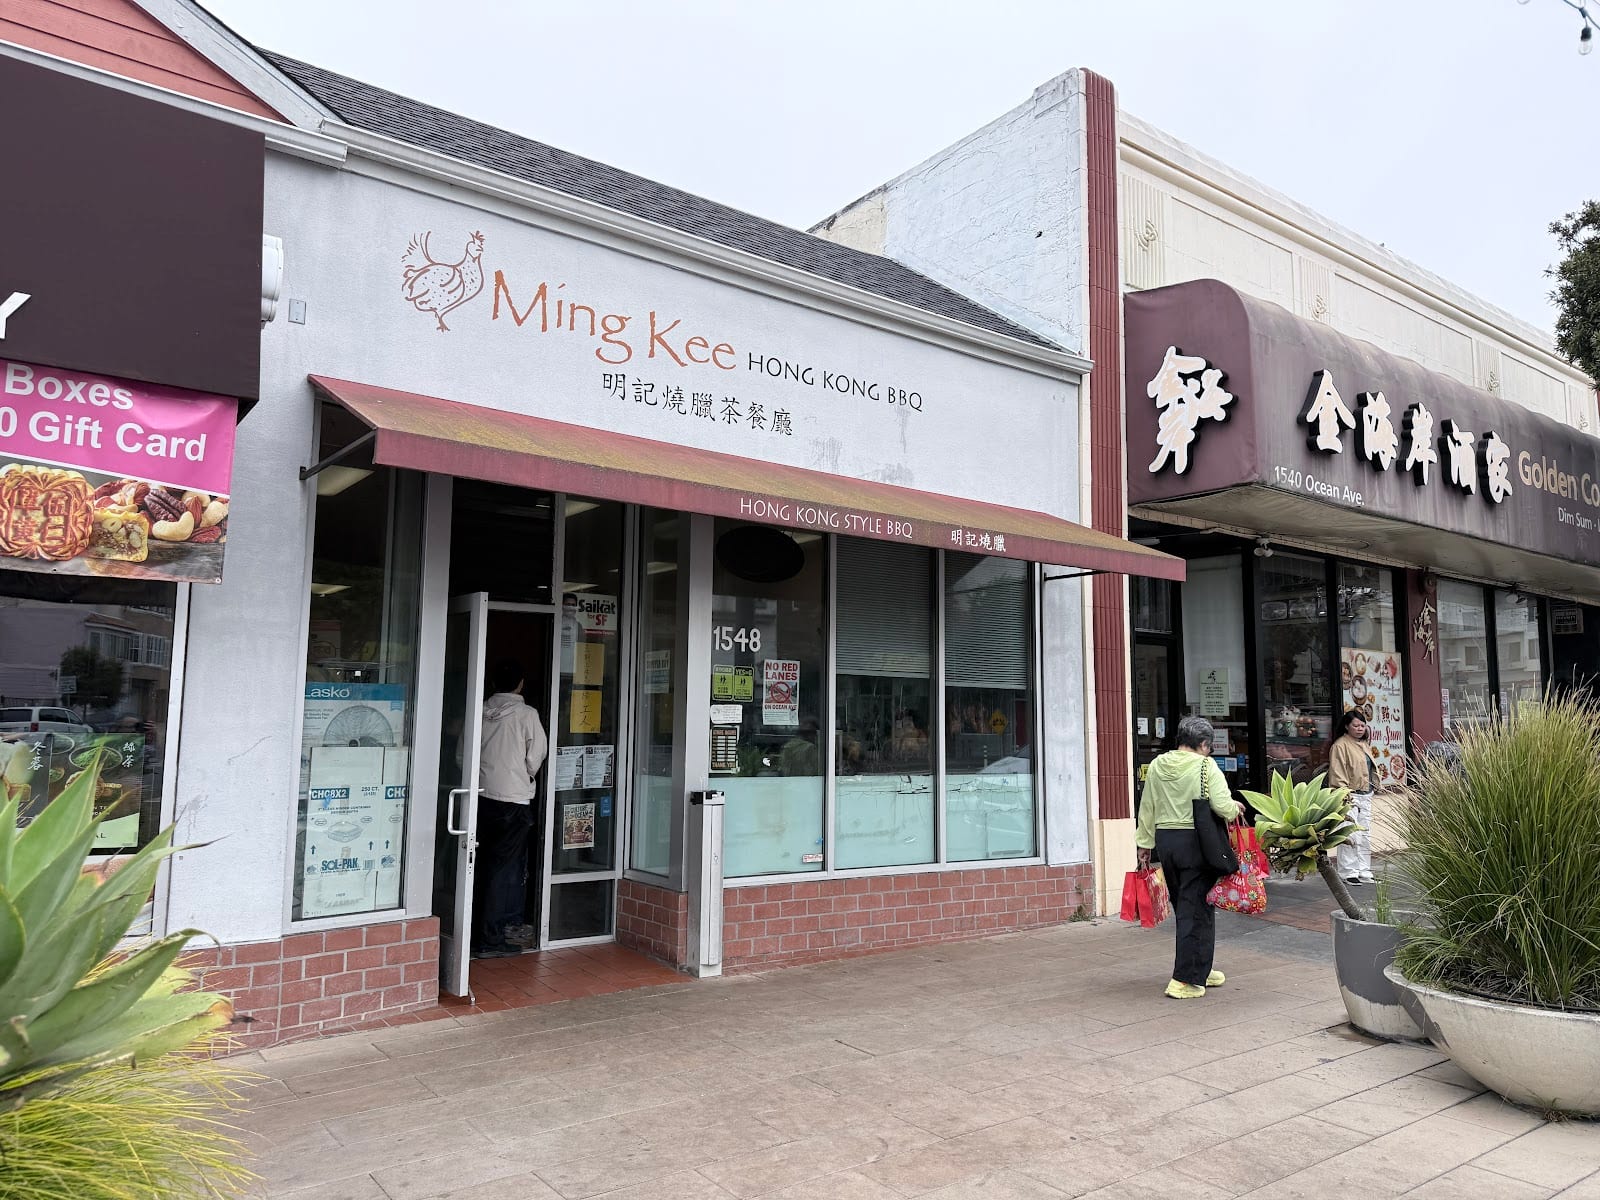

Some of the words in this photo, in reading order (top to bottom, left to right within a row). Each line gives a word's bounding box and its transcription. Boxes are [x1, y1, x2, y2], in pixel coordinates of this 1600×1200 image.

[491, 268, 633, 366] Ming
[647, 310, 737, 371] Kee
[5, 362, 135, 411] Boxes
[748, 352, 814, 386] HONG
[823, 370, 880, 401] KONG
[887, 386, 923, 413] BBQ
[602, 372, 794, 437] 明記燒臘茶餐廳
[28, 411, 103, 449] Gift
[115, 422, 207, 463] Card
[1304, 368, 1514, 505] 金海岸酒家
[1274, 465, 1302, 489] 1540
[1305, 474, 1340, 500] Ocean
[1342, 485, 1365, 506] Ave.
[1518, 450, 1578, 501] Golden
[1581, 472, 1600, 508] Co
[739, 497, 790, 521] HONG
[795, 506, 840, 529] KONG
[843, 513, 882, 535] STYLE
[887, 520, 913, 540] BBQ
[1558, 506, 1575, 526] Dim
[1575, 512, 1593, 531] Sum
[950, 529, 1007, 553] 明記燒臘
[578, 599, 616, 615] Saikat
[595, 613, 608, 626] SF
[713, 626, 761, 652] 1548
[765, 662, 780, 671] NO
[781, 662, 798, 672] RED
[765, 671, 798, 681] LANES
[321, 857, 359, 871] SOL-PAK
